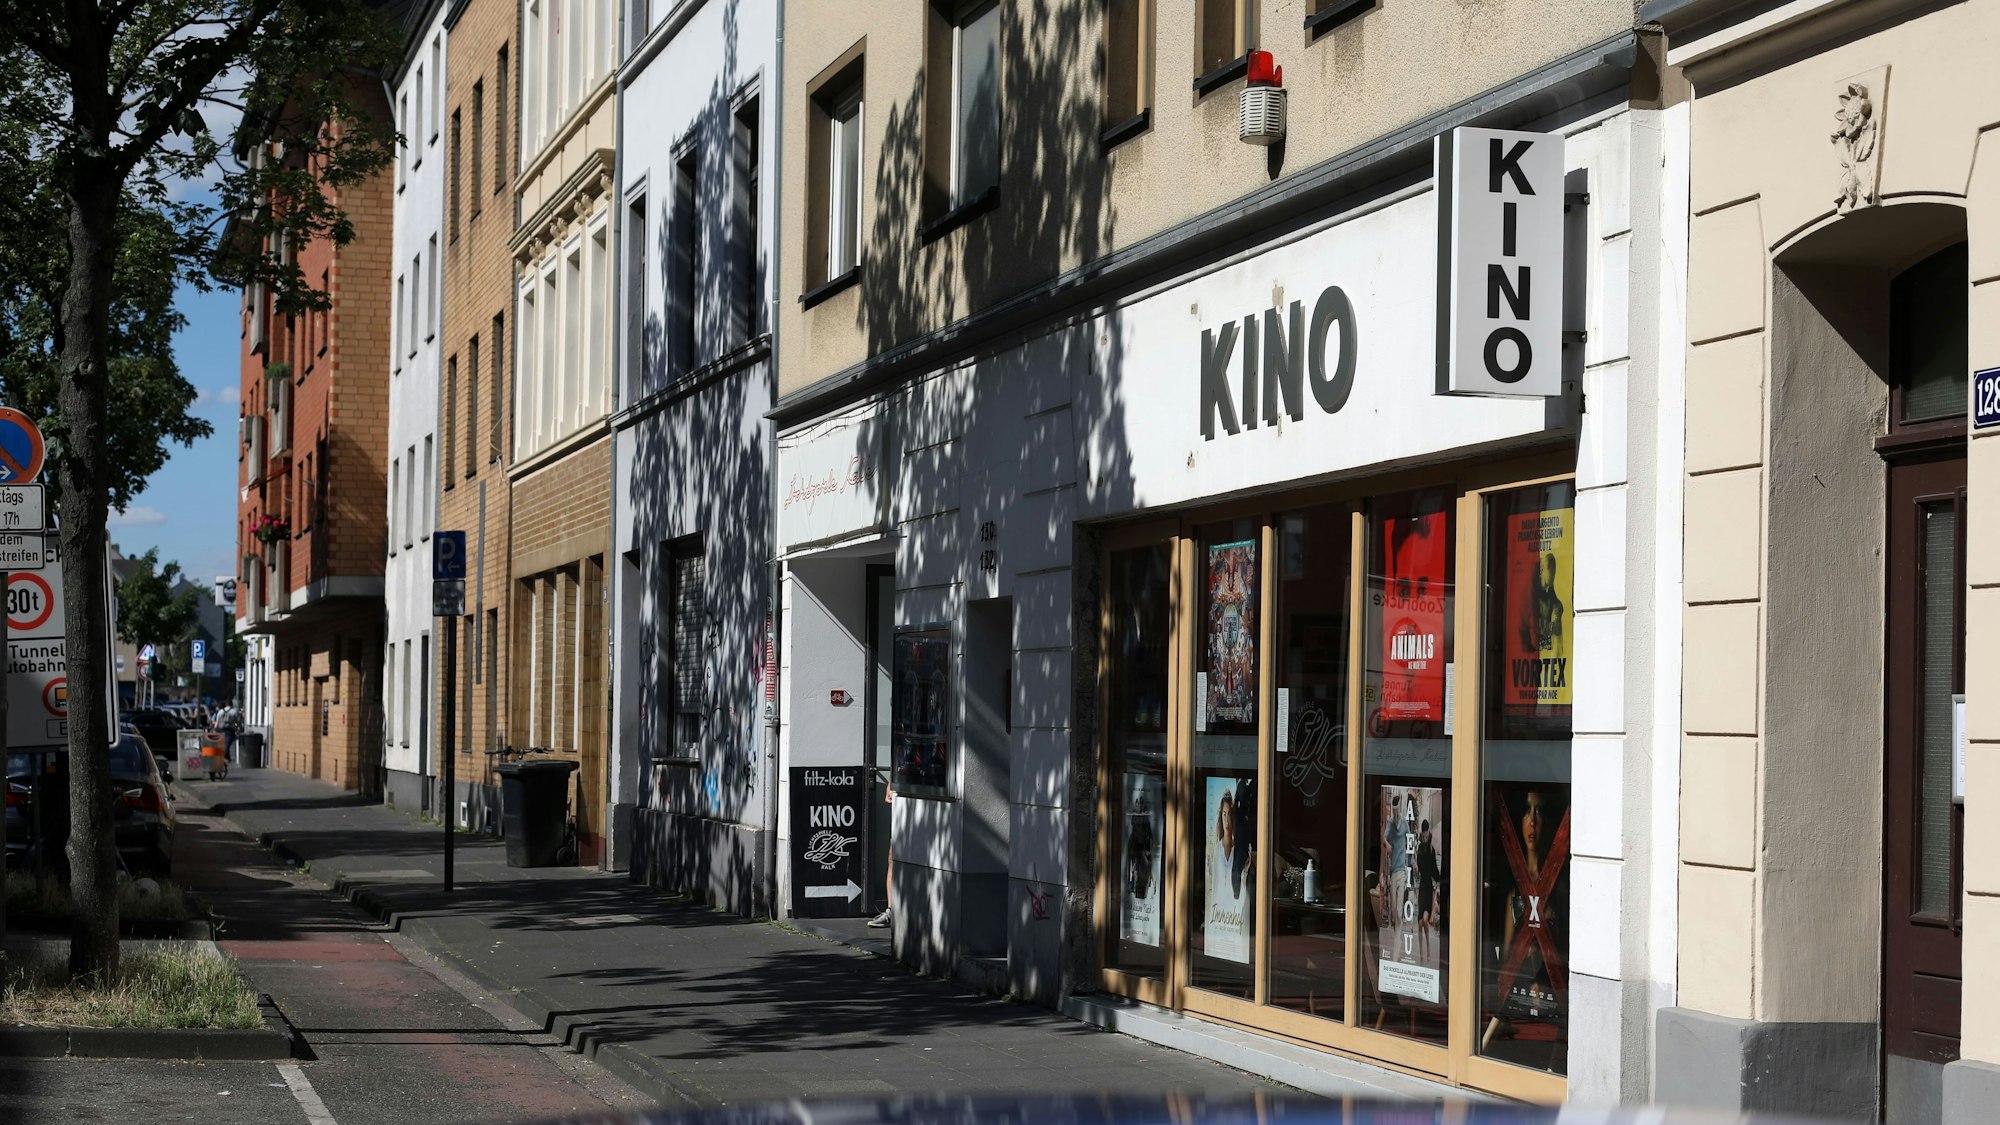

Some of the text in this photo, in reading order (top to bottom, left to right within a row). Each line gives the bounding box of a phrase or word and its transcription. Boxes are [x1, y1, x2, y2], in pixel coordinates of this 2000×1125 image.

[1483, 138, 1536, 384] KINO
[1200, 285, 1358, 442] KINO
[1977, 375, 2000, 417] 128
[0, 489, 24, 506] tags
[3, 511, 20, 526] 17h
[1536, 516, 1560, 529] ARGENTO
[1544, 527, 1563, 540] LEBRUN
[437, 537, 456, 573] P
[8, 643, 65, 659] Tunnel
[1391, 633, 1434, 660] ANIMALS
[1511, 657, 1567, 688] VORTEX
[803, 769, 855, 787] fritz-kola
[809, 805, 856, 828] KINO
[1528, 895, 1541, 922] X
